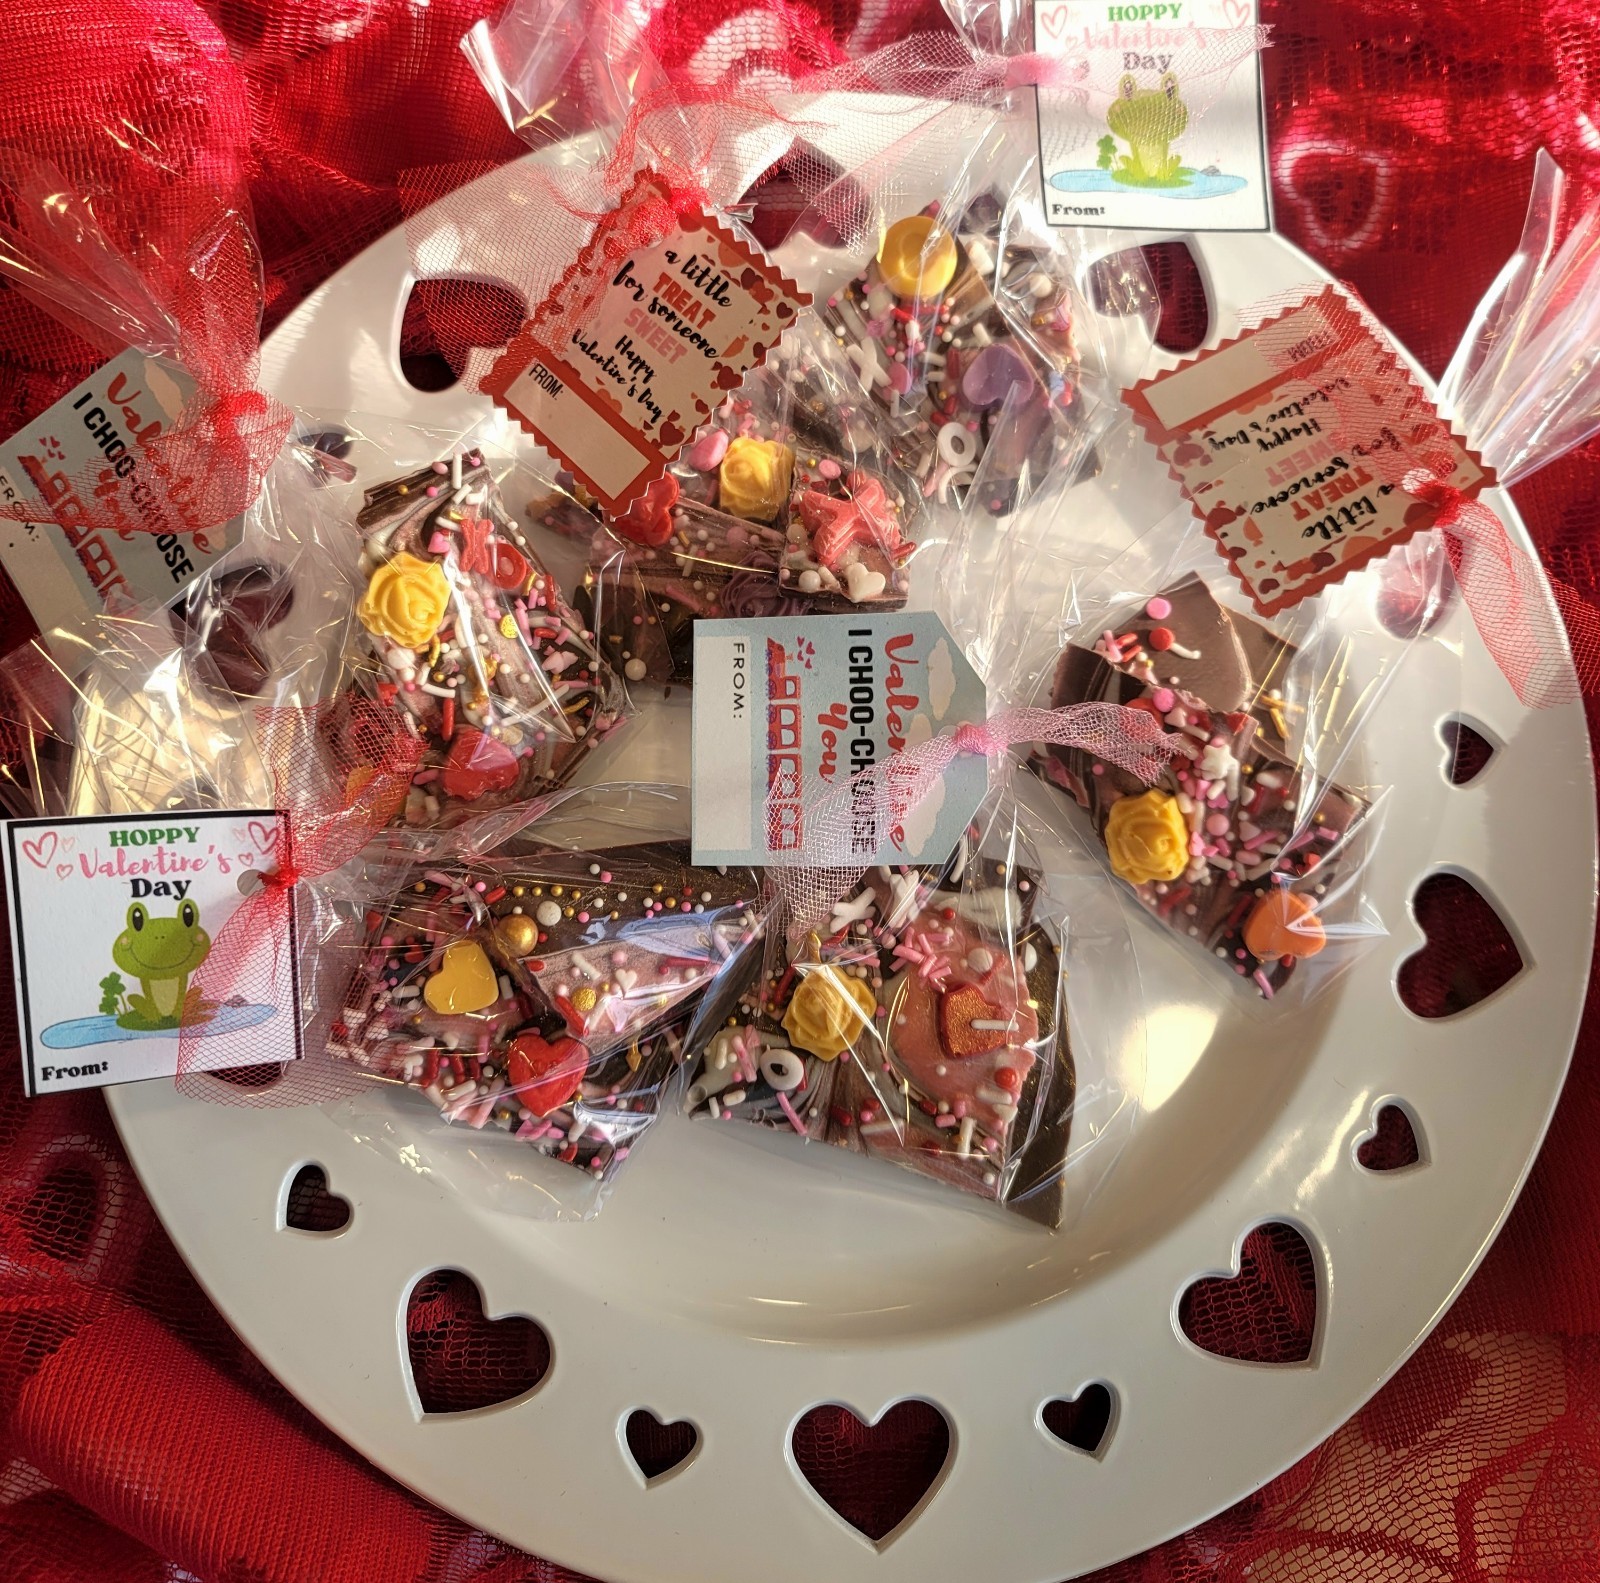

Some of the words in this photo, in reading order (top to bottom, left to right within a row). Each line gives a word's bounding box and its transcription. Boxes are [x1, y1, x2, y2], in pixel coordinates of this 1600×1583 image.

[1108, 4, 1182, 22] HOPPY
[1123, 52, 1173, 73] Day
[1052, 204, 1105, 216] From:
[665, 248, 680, 264] a
[681, 256, 731, 307] little
[613, 260, 648, 302] for
[648, 295, 719, 358] someone
[652, 272, 716, 330] TREAT
[624, 308, 688, 365] SWEET
[572, 329, 637, 397] Valentine's
[637, 389, 665, 422] Day
[615, 335, 658, 381] Happy
[528, 364, 564, 400] FROM:
[73, 392, 92, 409] I
[1209, 429, 1250, 450] Day
[1257, 418, 1322, 453] Happy
[1352, 427, 1401, 457] for
[1267, 435, 1345, 486] SWEET
[1250, 457, 1350, 515] someone
[1292, 466, 1373, 521] TREAT
[1376, 483, 1395, 498] a
[1303, 497, 1377, 540] little
[733, 642, 745, 719] FROM:
[818, 703, 848, 784] You
[109, 827, 200, 847] HOPPY
[79, 845, 233, 879] Valentine's
[130, 877, 191, 901] Day
[42, 1060, 108, 1081] From:
